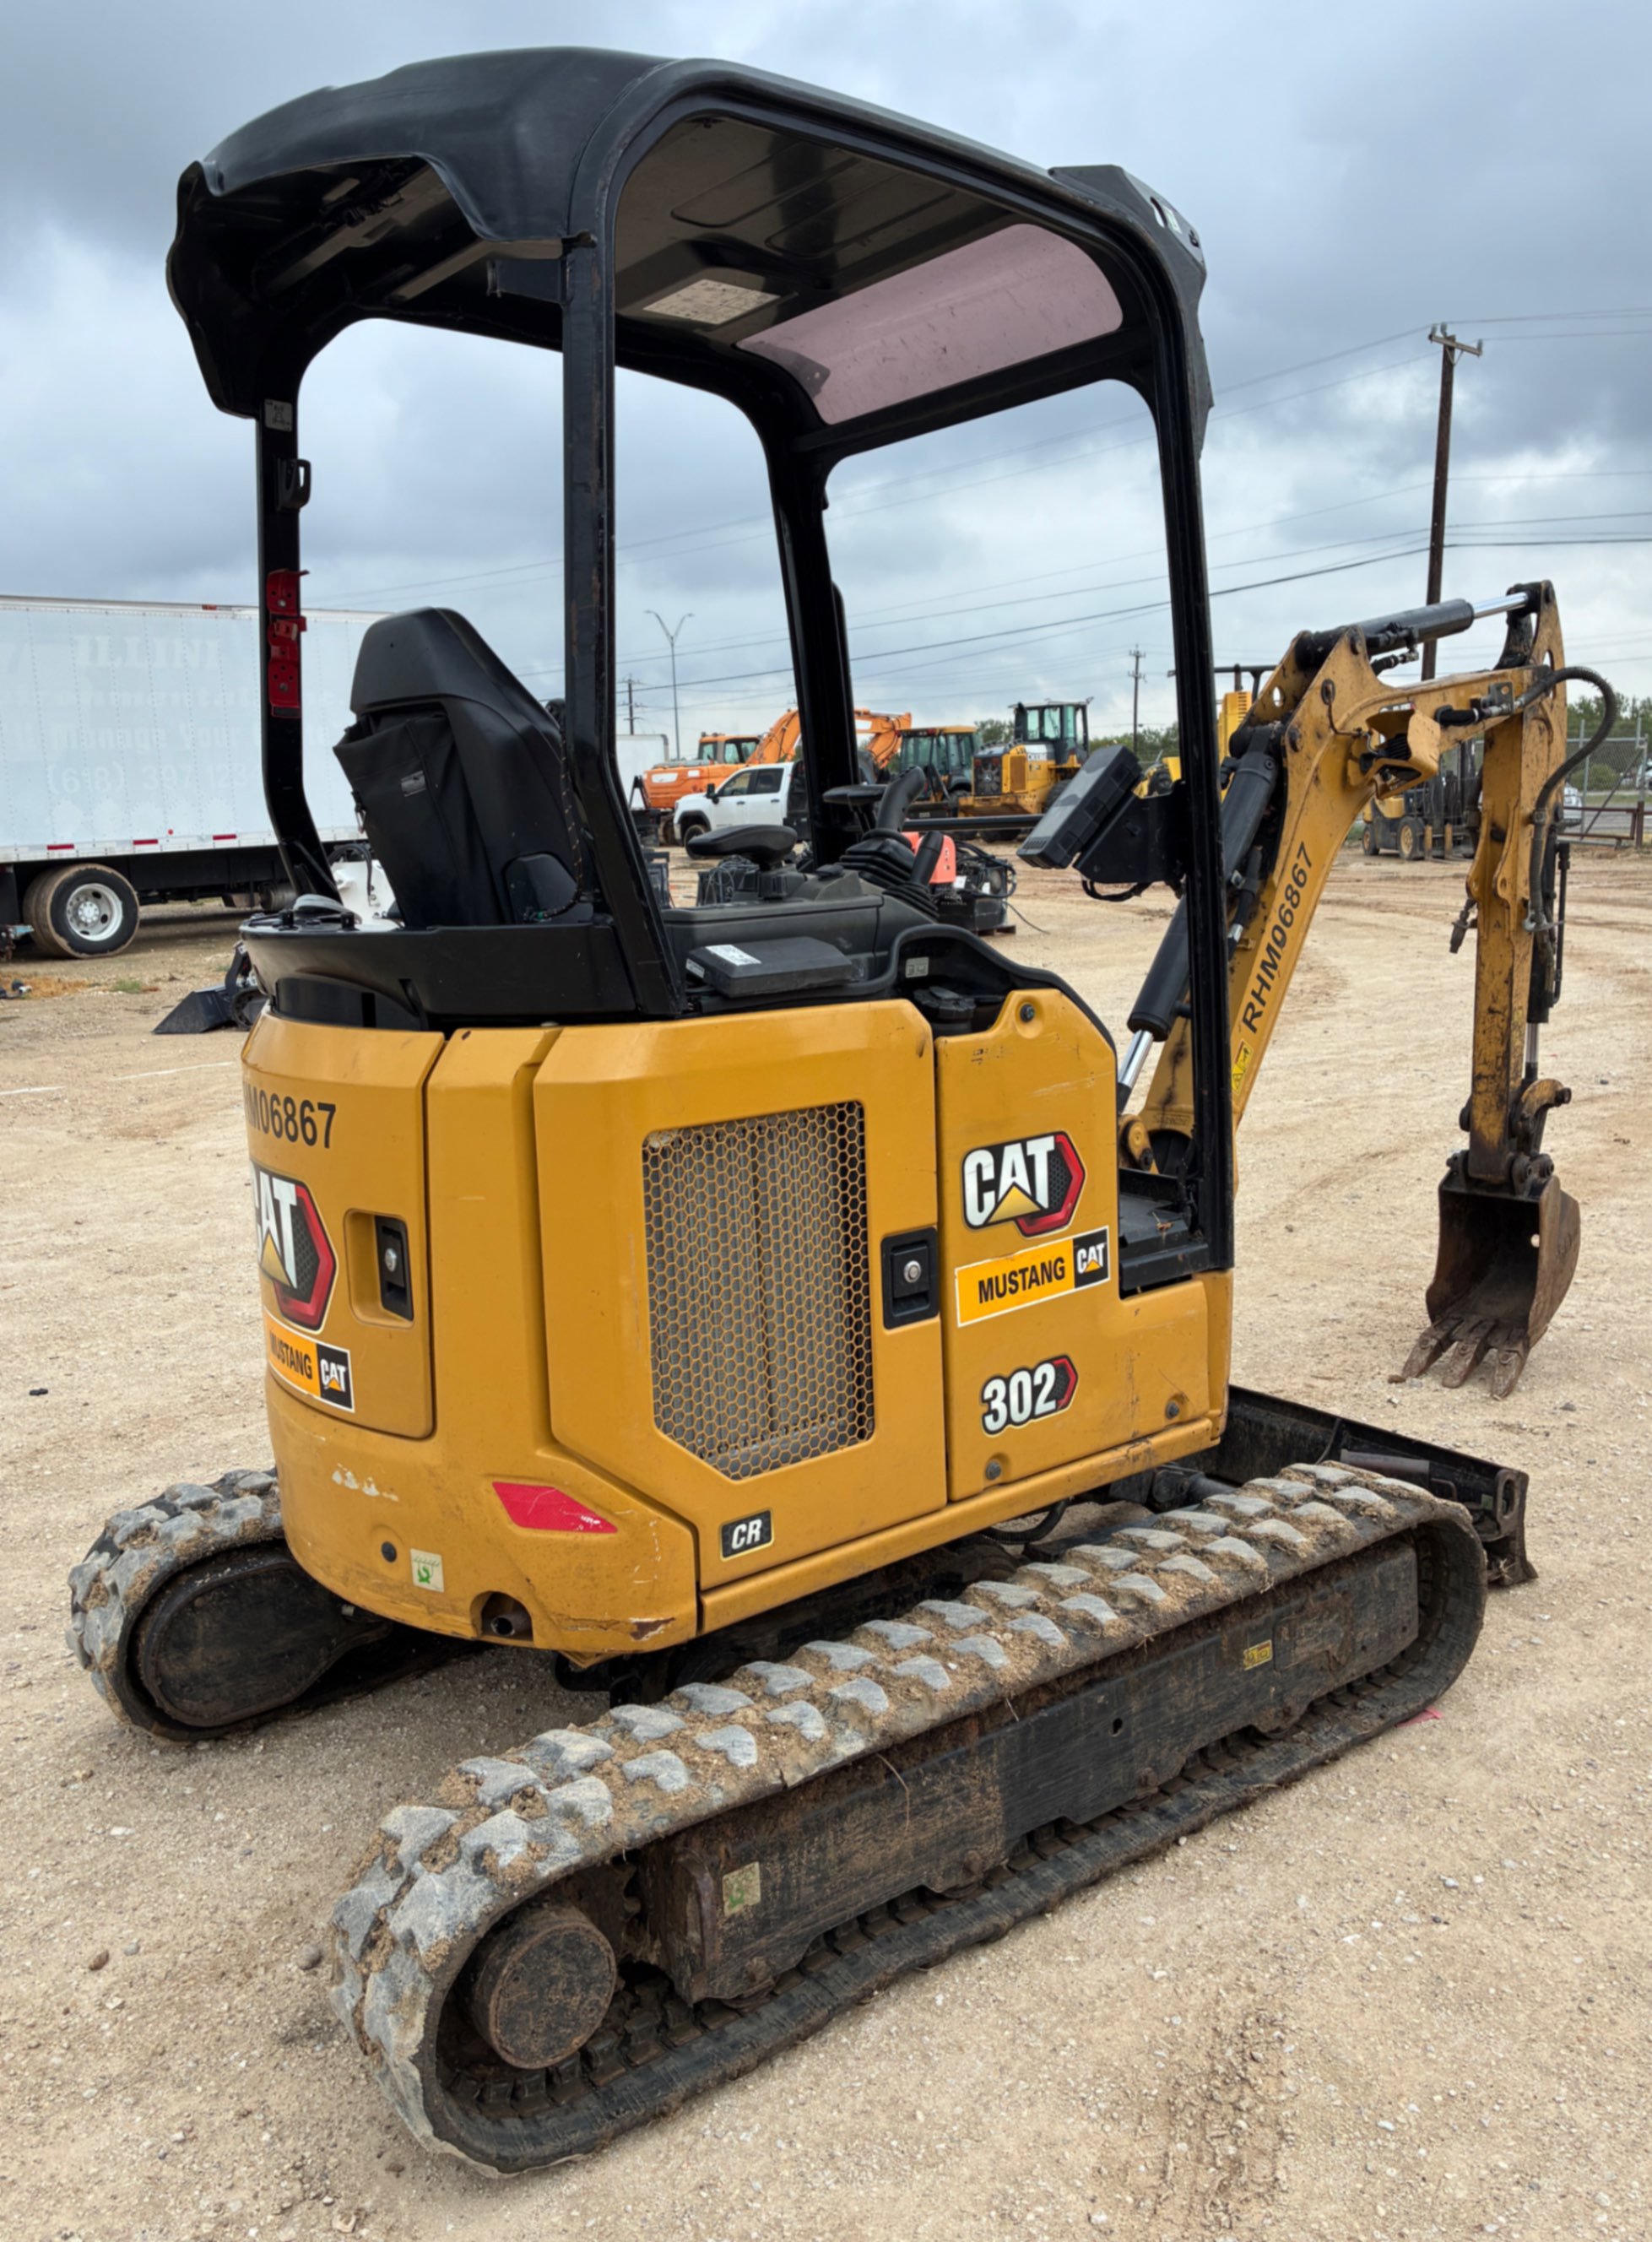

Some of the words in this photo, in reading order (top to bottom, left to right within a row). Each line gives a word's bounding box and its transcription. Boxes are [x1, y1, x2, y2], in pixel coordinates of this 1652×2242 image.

[1242, 841, 1313, 1034] RHM06867
[963, 1135, 1055, 1227] CAT
[978, 1256, 1066, 1304] MUSTANG
[1077, 1242, 1106, 1275] CAT
[320, 1358, 346, 1392] CAT
[983, 1361, 1057, 1432] 302
[731, 1519, 762, 1550] CR
